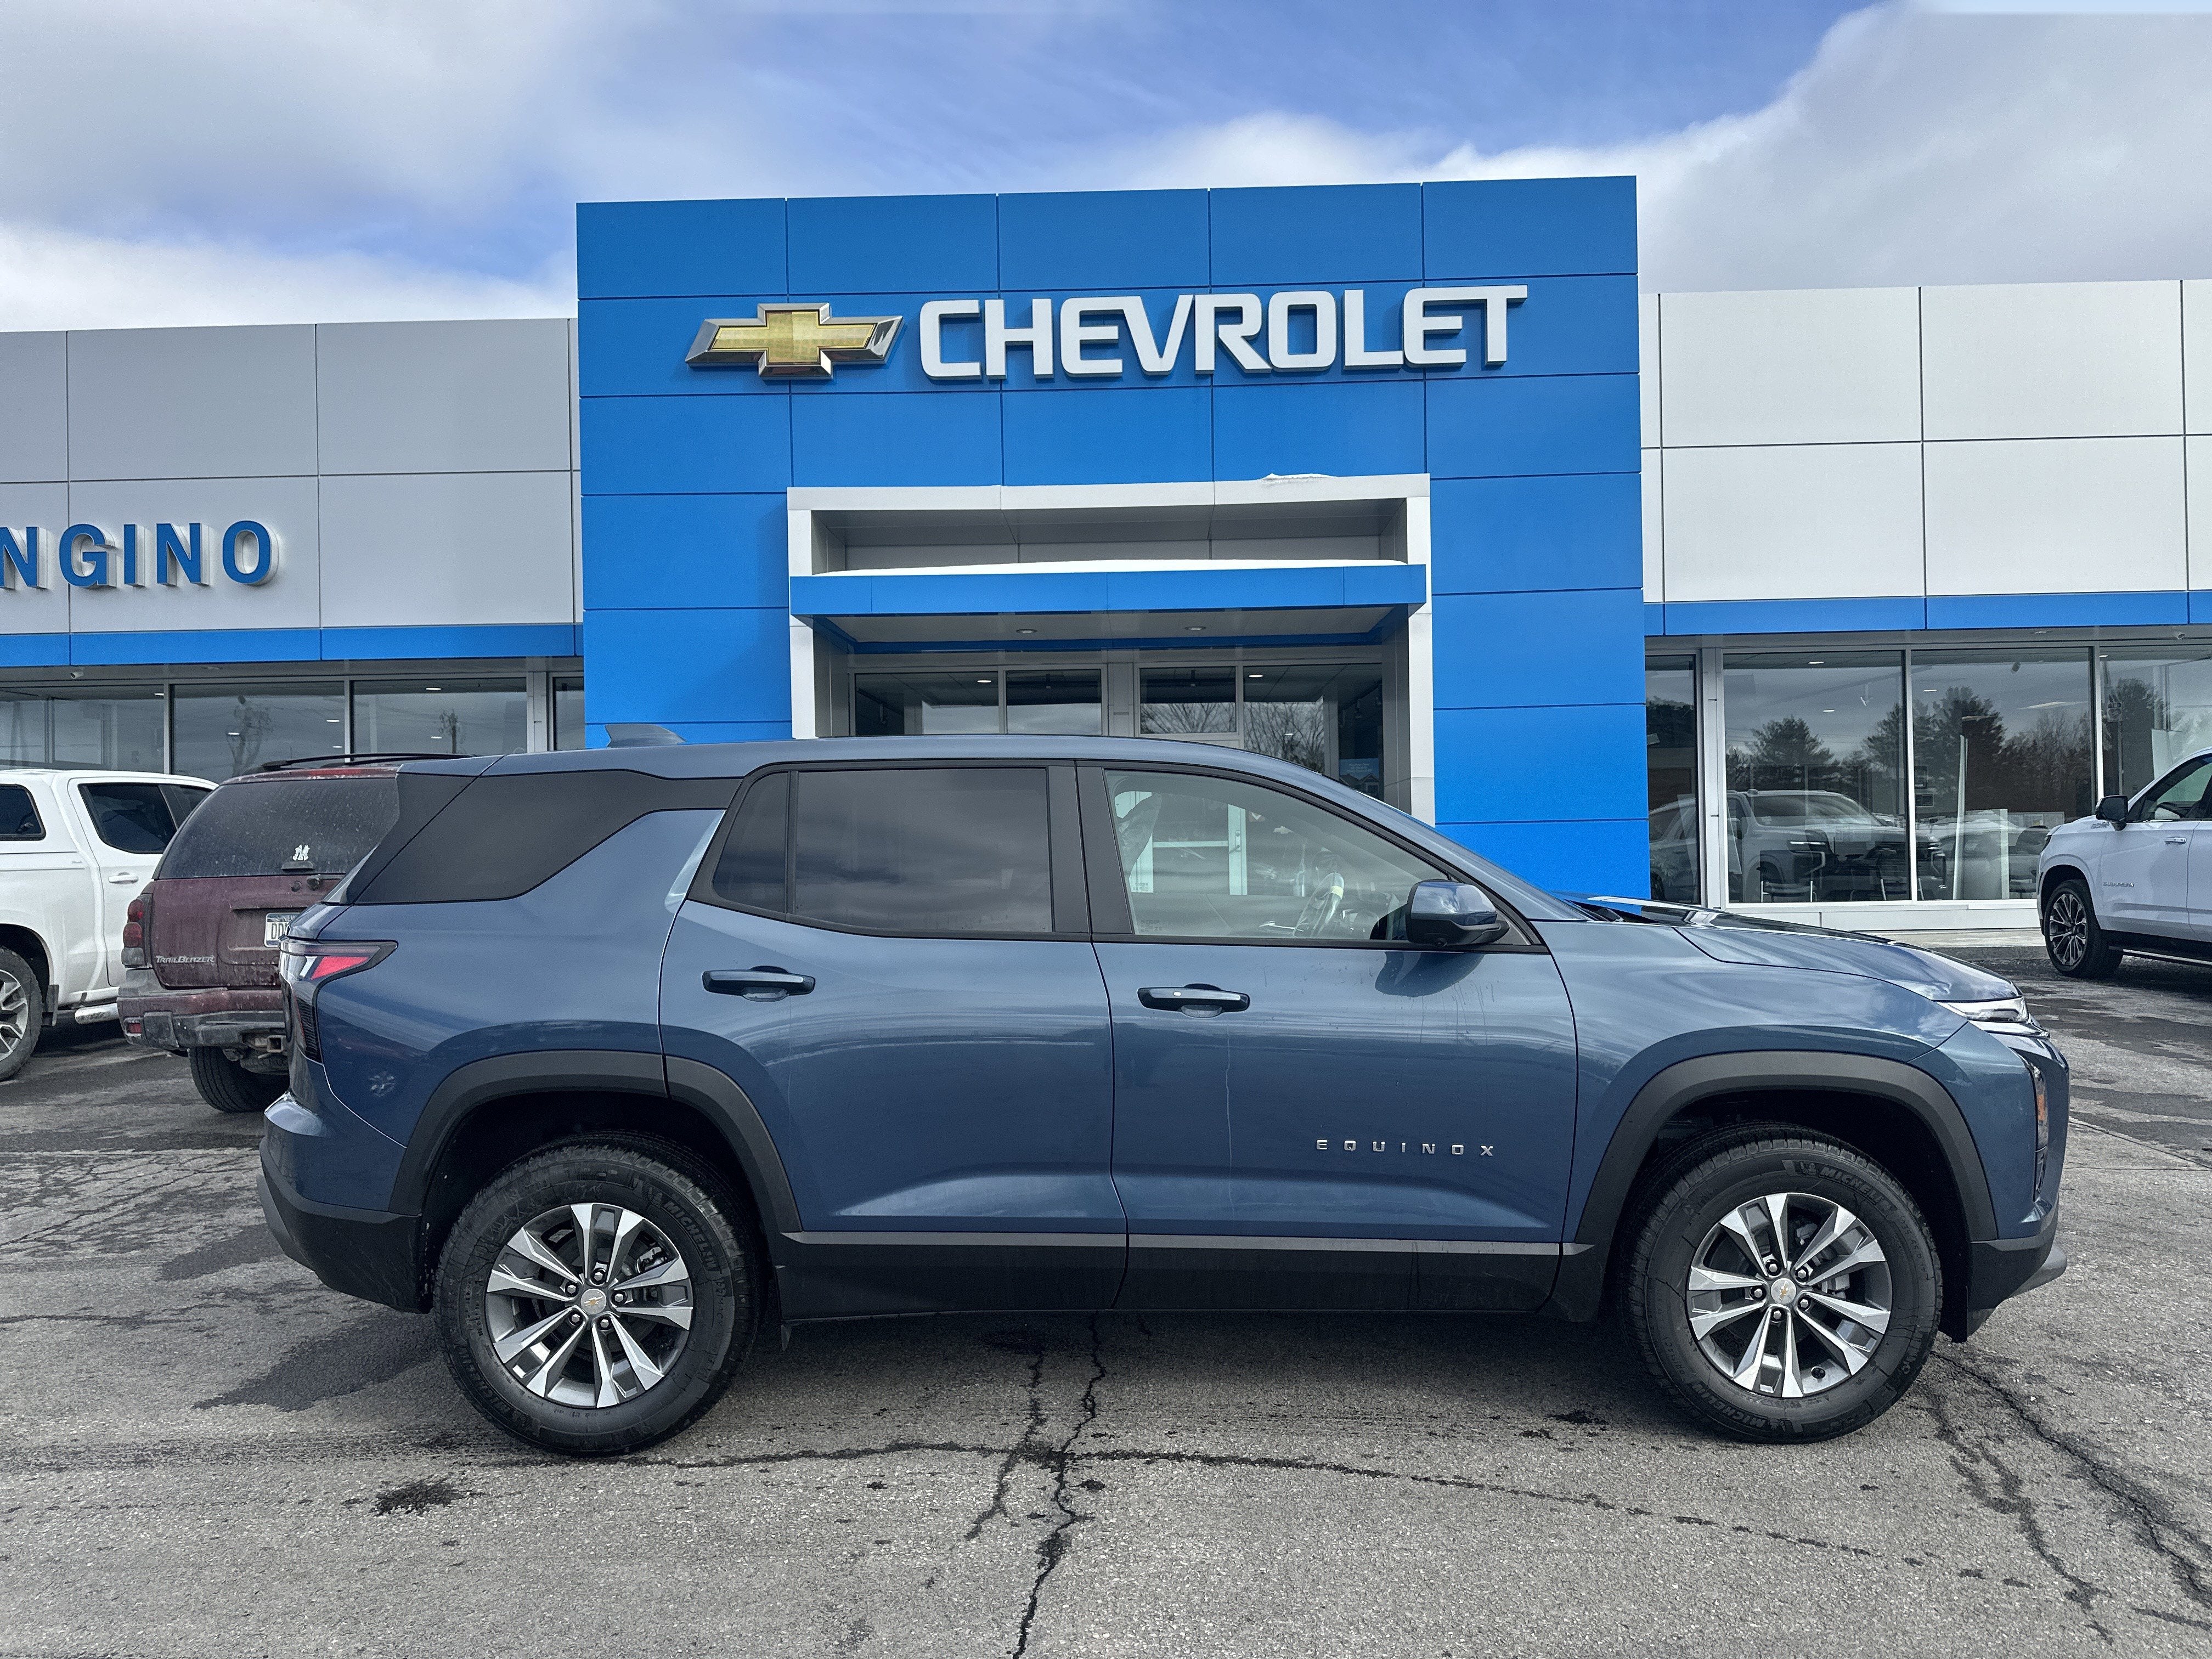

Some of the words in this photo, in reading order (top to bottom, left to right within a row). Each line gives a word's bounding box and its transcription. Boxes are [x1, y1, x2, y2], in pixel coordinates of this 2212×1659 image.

[919, 285, 1528, 380] CHEVROLET
[0, 520, 278, 589] NGINO
[1316, 1139, 1493, 1156] EQUINOX
[1820, 1166, 1892, 1212] MICHELI
[663, 1200, 718, 1268] MICHELIN
[1691, 1383, 1766, 1429] MICHELIN
